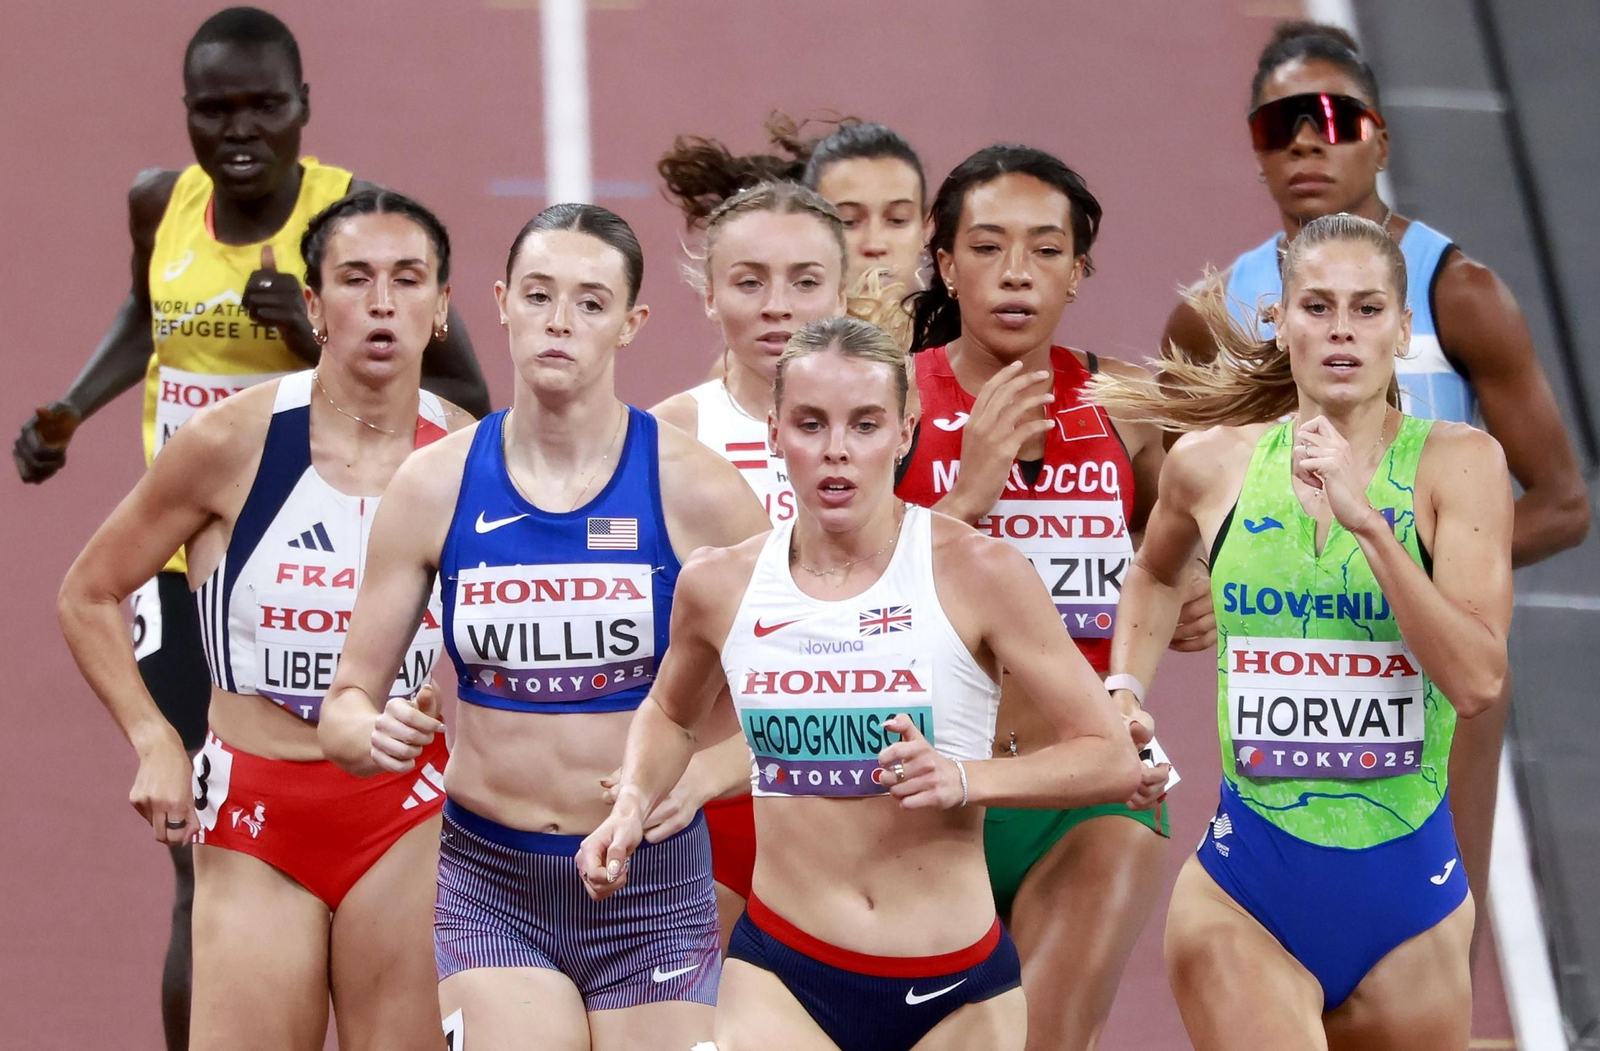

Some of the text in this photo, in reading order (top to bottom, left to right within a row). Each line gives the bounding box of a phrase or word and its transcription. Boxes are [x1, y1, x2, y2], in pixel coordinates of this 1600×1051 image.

[933, 459, 1118, 495] MOCCO
[460, 577, 647, 606] HONDA
[1223, 582, 1395, 620] SLOVENIJ
[467, 618, 640, 662] WILLIS
[799, 639, 864, 655] Novuna
[1232, 650, 1419, 678] HONDA
[507, 665, 644, 693] TOKYO 25
[741, 669, 927, 694] HONDA
[1237, 695, 1413, 738] HORVAT
[1272, 750, 1415, 769] TOKYO 25
